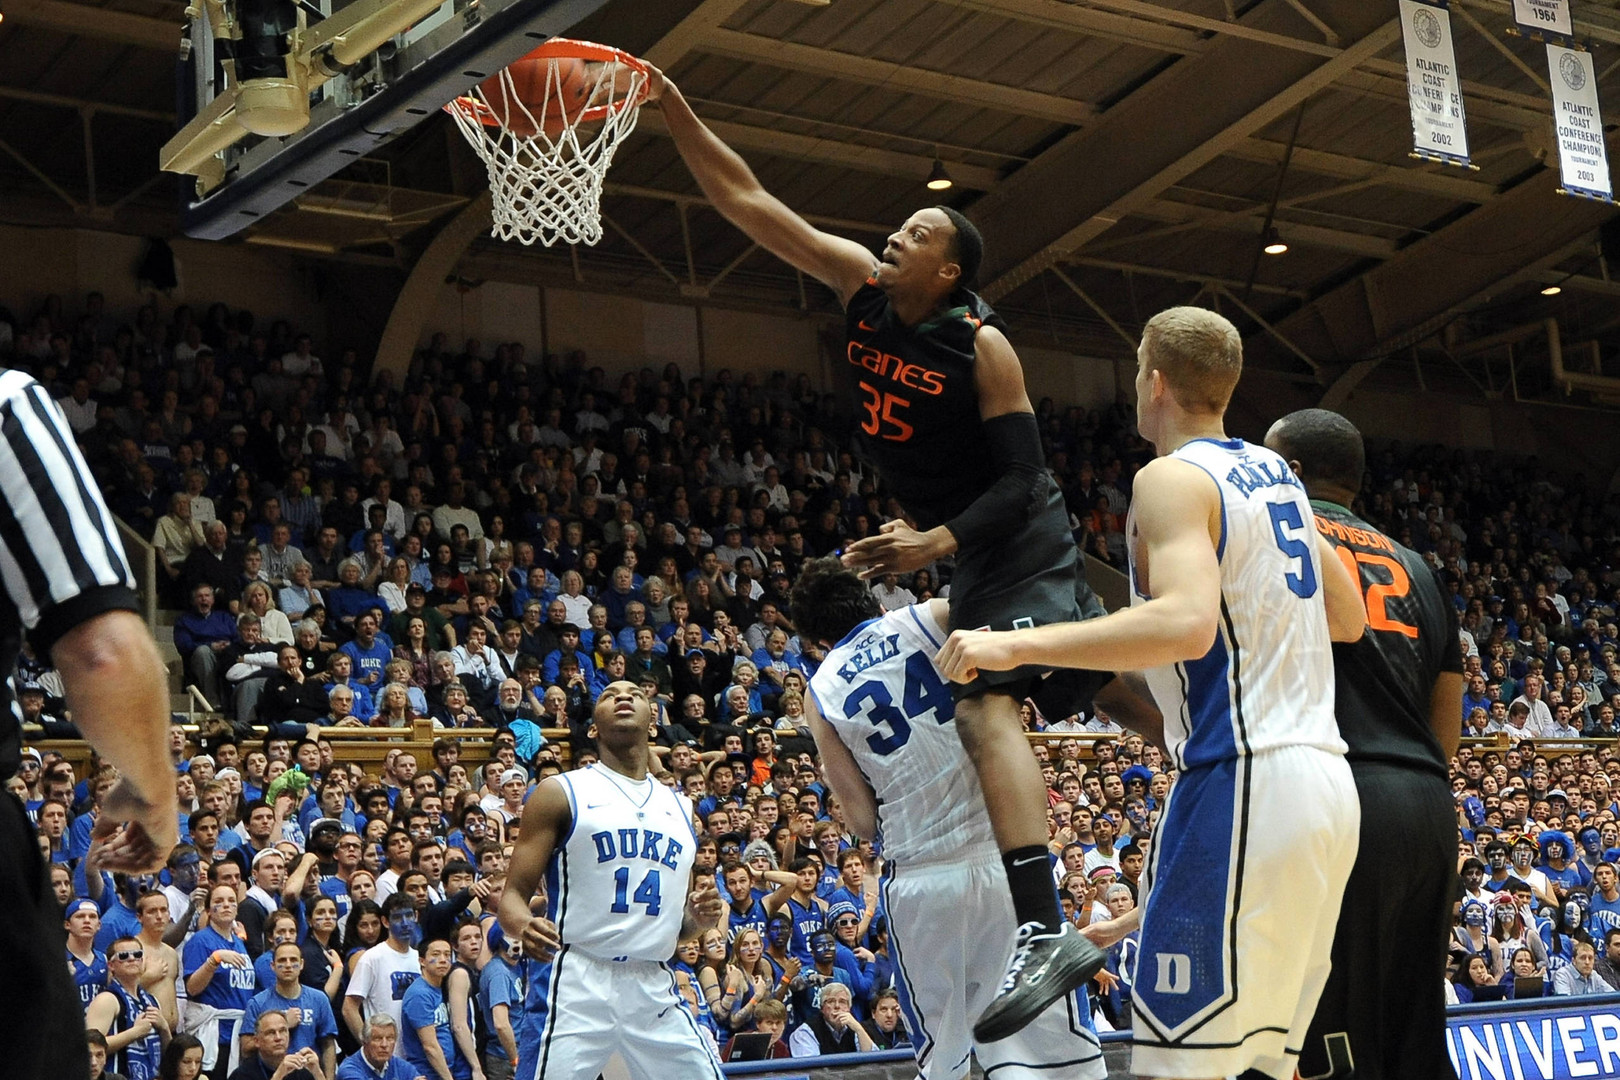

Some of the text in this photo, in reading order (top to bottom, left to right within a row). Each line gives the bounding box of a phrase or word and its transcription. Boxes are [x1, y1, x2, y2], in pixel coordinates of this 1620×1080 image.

[1532, 7, 1557, 23] 1964
[1415, 57, 1450, 75] ATLANTIC
[1423, 73, 1446, 88] COAST
[1412, 84, 1459, 105] CONFERCE
[1562, 101, 1593, 117] ATLANTIC
[1569, 115, 1590, 129] COAST
[1432, 132, 1452, 146] 2002
[1559, 126, 1602, 145] CONFERENCE
[1563, 140, 1602, 157] CHAMPIONS
[1577, 170, 1595, 182] 2003
[859, 380, 914, 442] 35
[1314, 515, 1395, 553] OHNSON
[1266, 501, 1317, 599] 5
[361, 658, 381, 668] DUKE
[837, 633, 901, 684] KELLY
[843, 650, 955, 756] 34
[591, 828, 683, 871] DUKE
[610, 867, 661, 916] 14
[799, 920, 822, 935] DUKE
